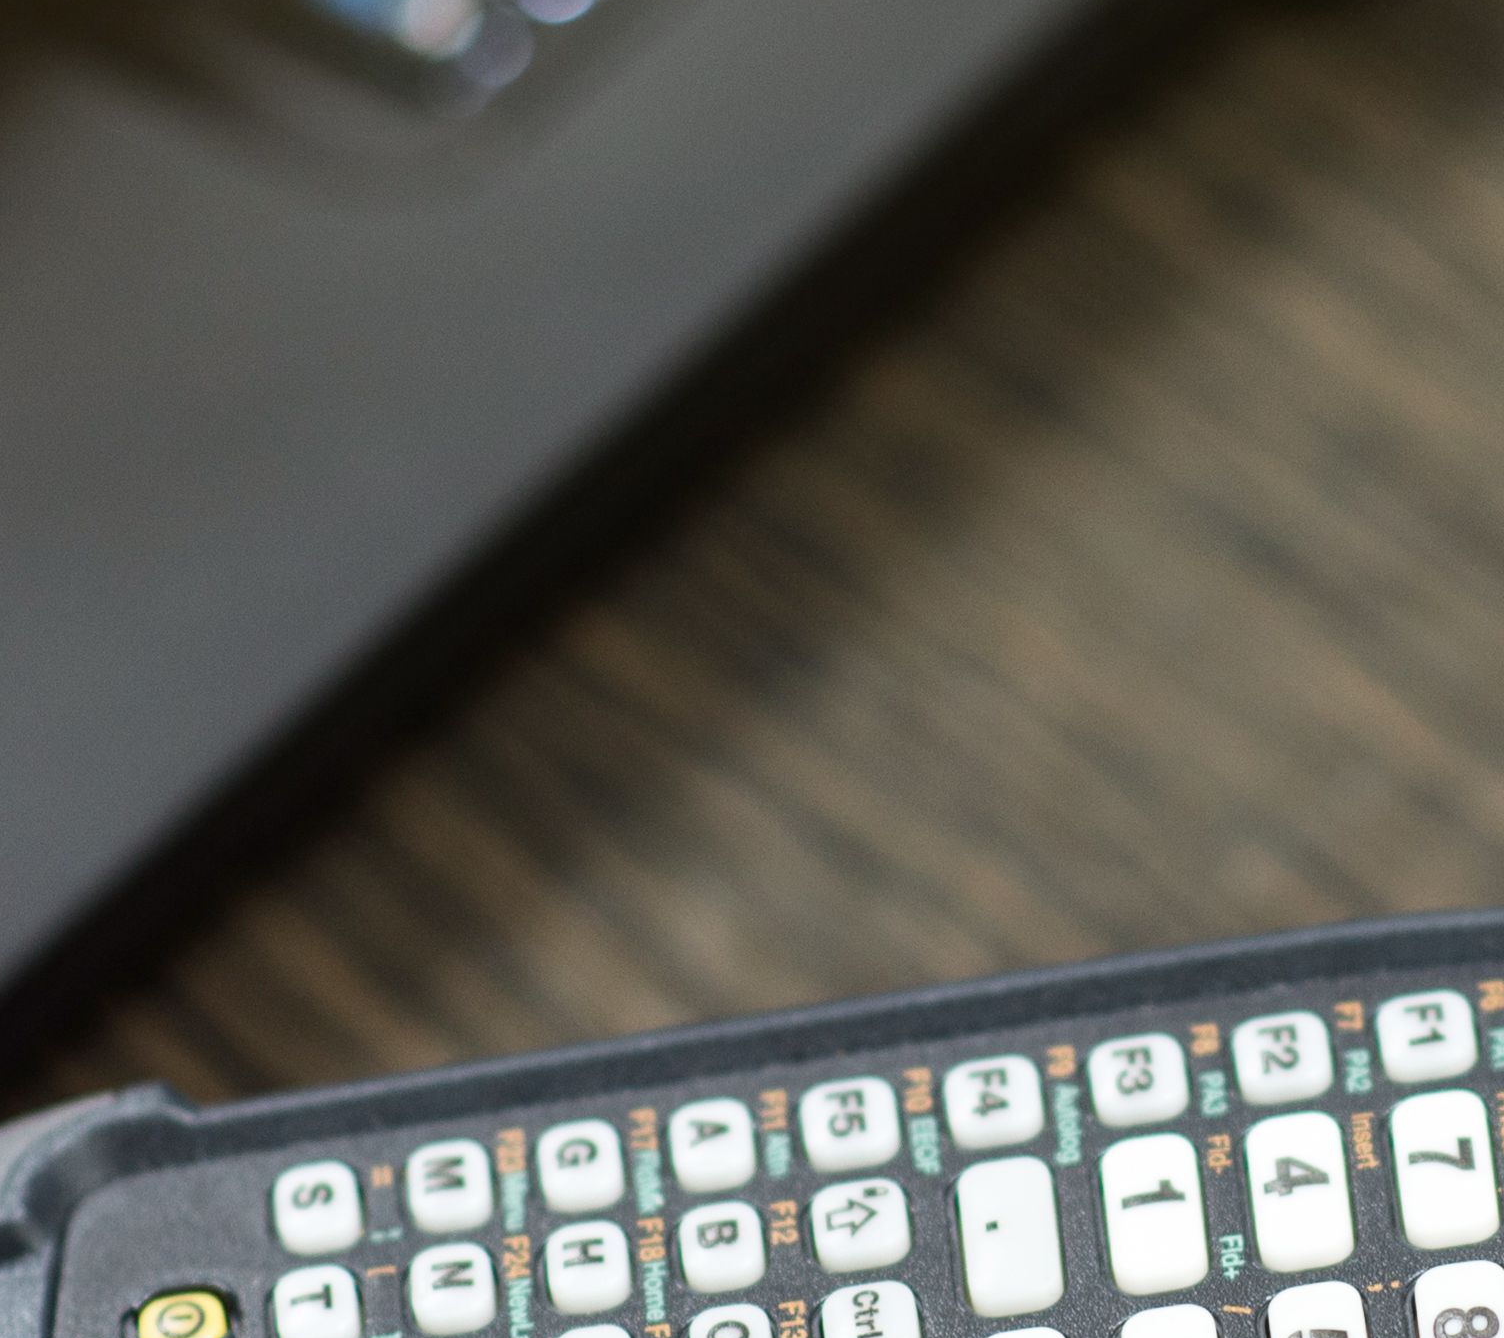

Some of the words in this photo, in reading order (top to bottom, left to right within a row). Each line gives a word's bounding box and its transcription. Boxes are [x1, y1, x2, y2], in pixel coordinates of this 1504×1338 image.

[1334, 1000, 1364, 1032] F7
[1404, 1002, 1445, 1047] F1
[1112, 1045, 1154, 1096] F3
[1257, 1024, 1300, 1075] F2
[903, 1067, 933, 1112] F10
[968, 1067, 1009, 1117] F4
[1198, 1070, 1228, 1116] PA3
[1344, 1049, 1372, 1095] PA2
[628, 1108, 658, 1150] F17
[759, 1089, 788, 1131] F11
[825, 1088, 866, 1138] F5
[1054, 1083, 1082, 1166] Autolog
[556, 1138, 599, 1169] G
[688, 1120, 731, 1148] A
[1351, 1112, 1379, 1170] Insert
[1408, 1136, 1476, 1171] 7
[292, 1182, 334, 1210] S
[423, 1156, 466, 1195] M
[1121, 1179, 1186, 1210] 1
[1263, 1156, 1330, 1197] 4
[636, 1216, 665, 1261] F18
[696, 1219, 739, 1249] B
[769, 1199, 798, 1246] F12
[985, 1220, 999, 1232] .
[502, 1234, 532, 1279] F24
[562, 1237, 605, 1268] H
[1219, 1234, 1244, 1280] Fld+
[289, 1283, 333, 1309] T
[431, 1260, 475, 1290] N
[642, 1261, 667, 1322] Home
